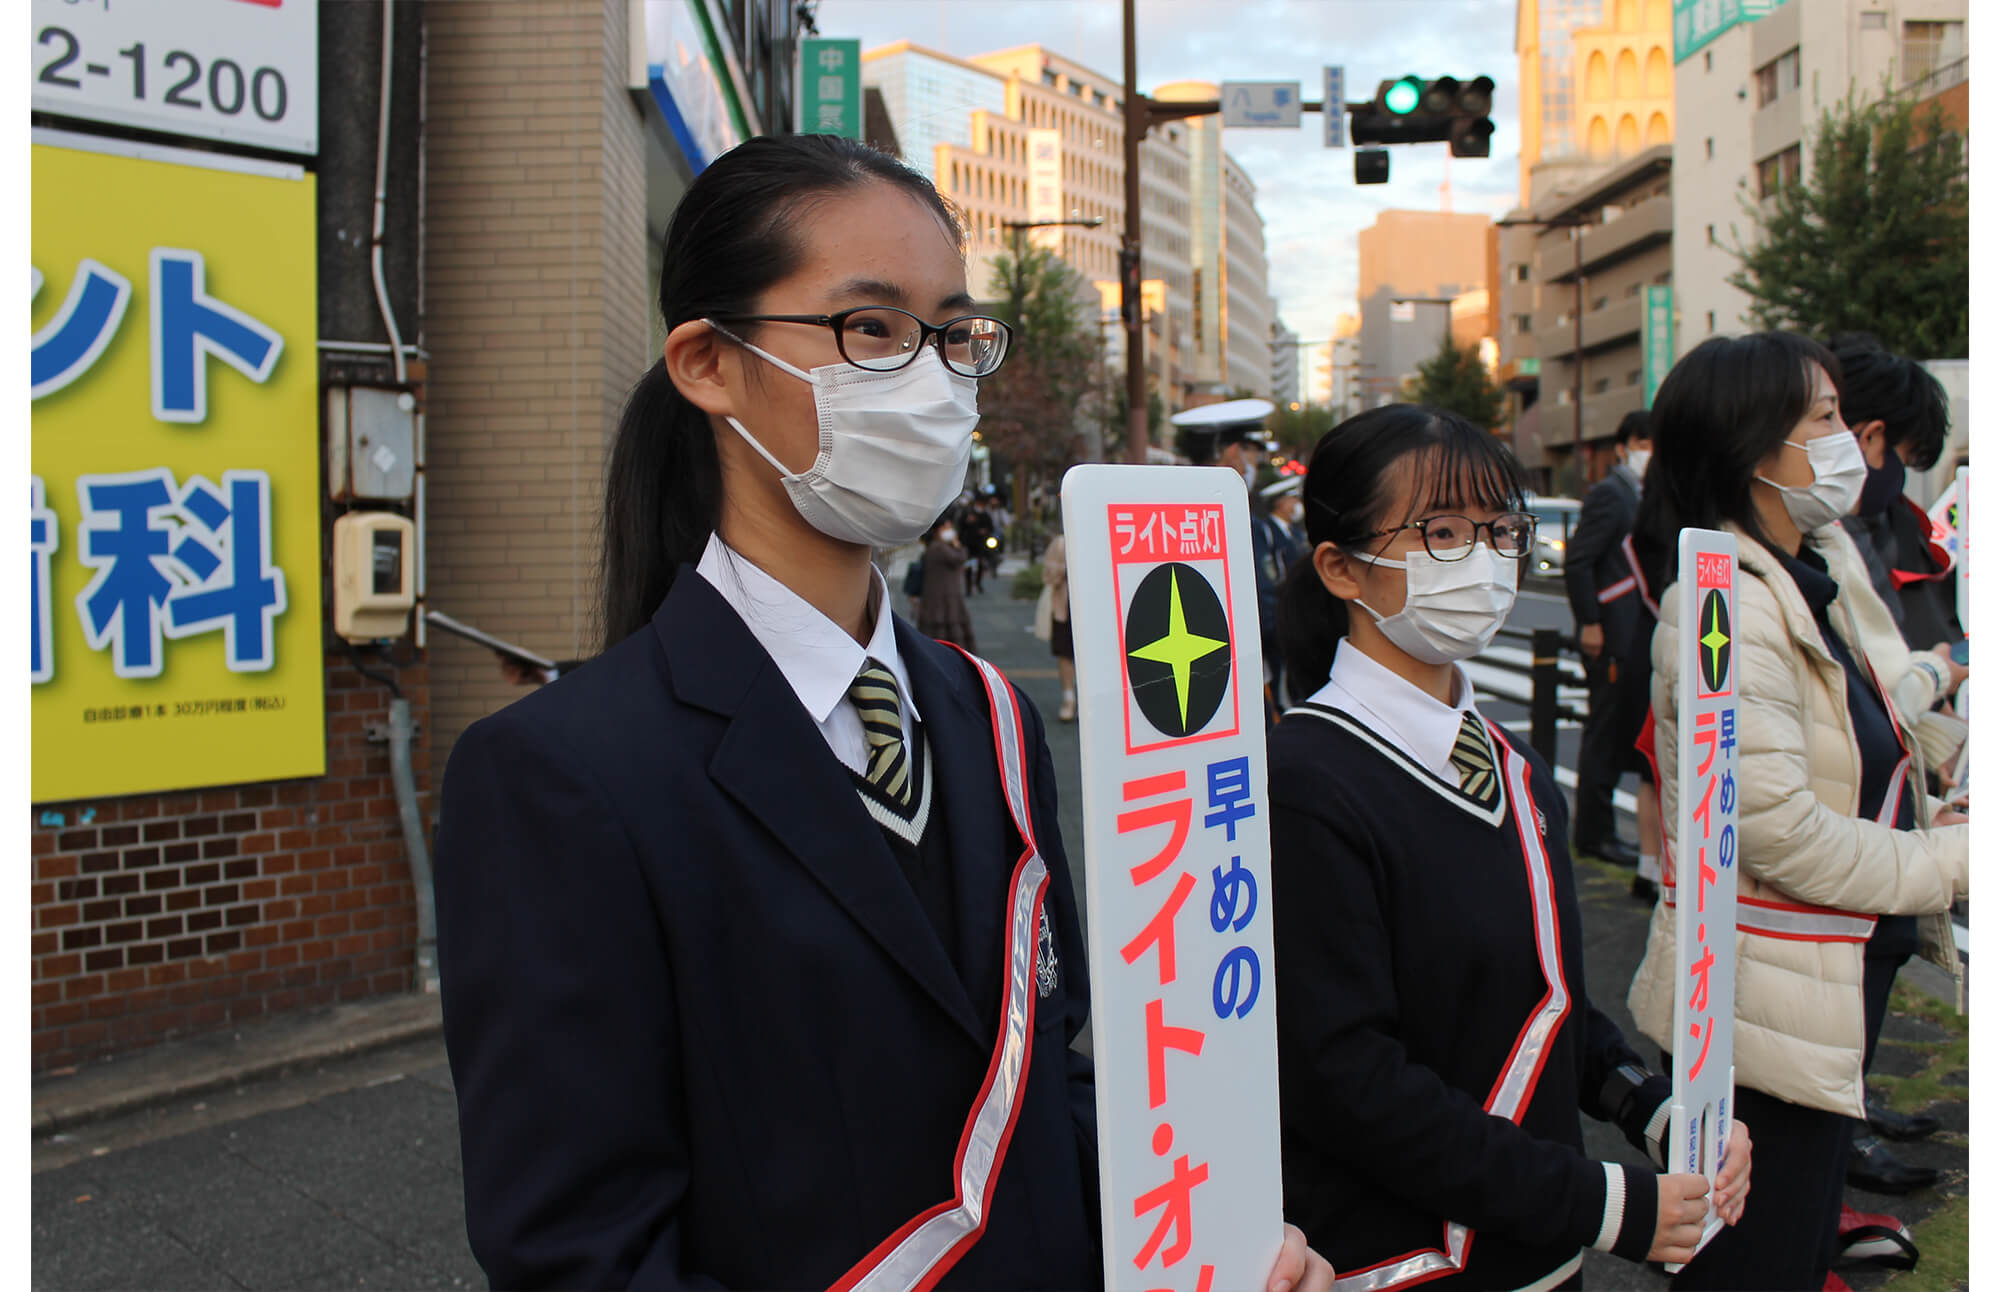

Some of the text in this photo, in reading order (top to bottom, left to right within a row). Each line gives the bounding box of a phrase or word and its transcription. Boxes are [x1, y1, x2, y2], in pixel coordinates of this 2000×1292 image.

[37, 26, 288, 122] 2-1200
[31, 470, 285, 678] 科
[1116, 509, 1221, 555] ライト点灯
[1204, 756, 1262, 1020] 早めの
[1719, 708, 1736, 869] 早めの
[1688, 711, 1718, 1083] ライト・オン
[1117, 770, 1214, 1292] ライト・オ
